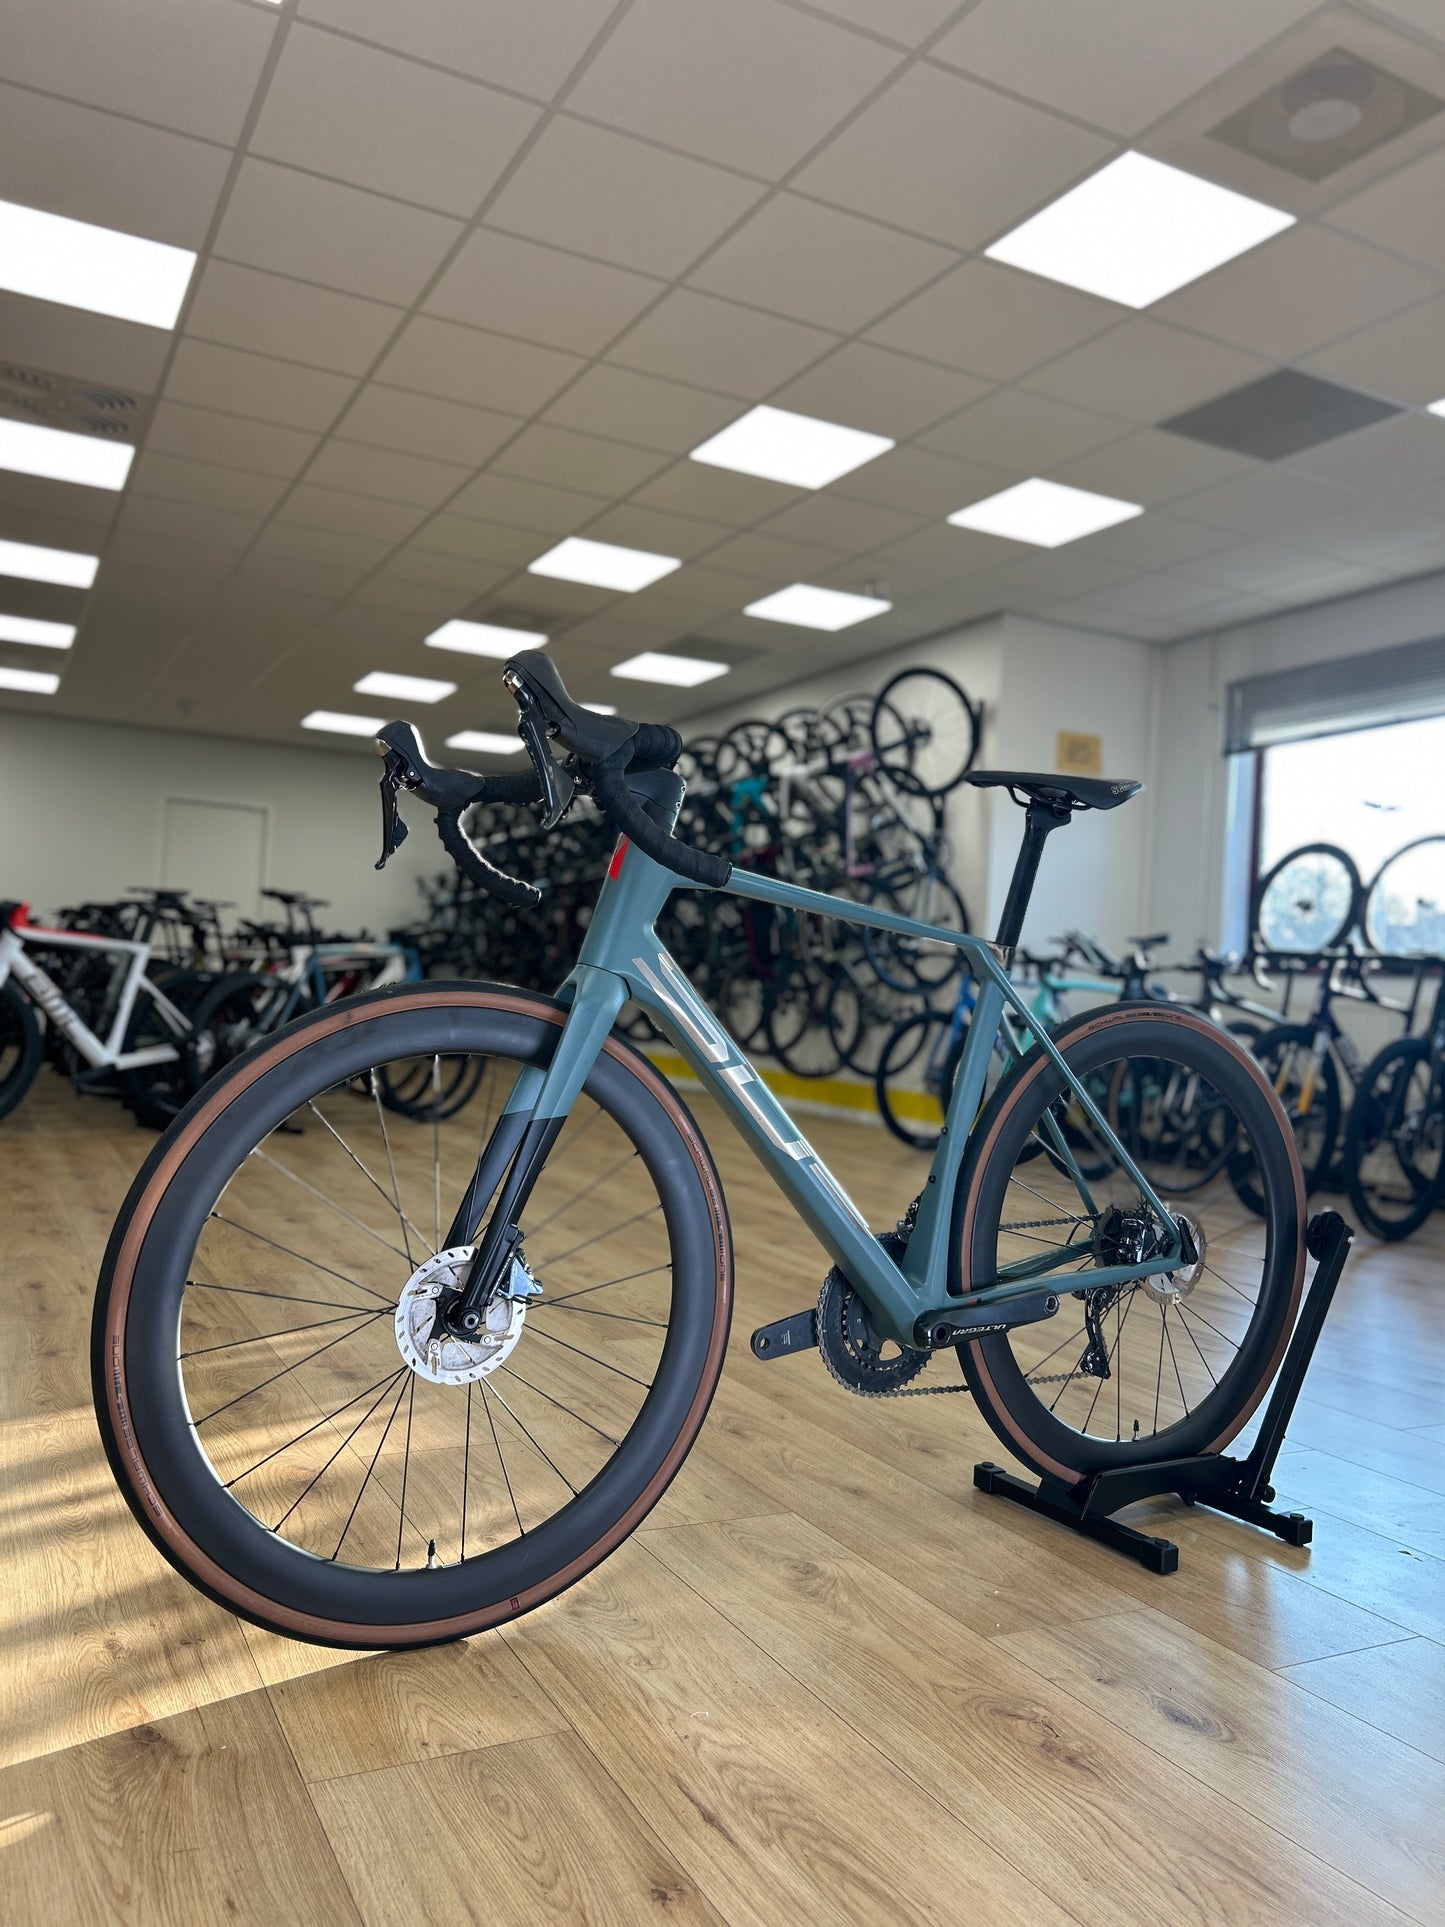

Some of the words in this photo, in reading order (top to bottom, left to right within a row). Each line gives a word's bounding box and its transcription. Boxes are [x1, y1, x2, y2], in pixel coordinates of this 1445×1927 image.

[952, 1324, 1007, 1336] ULTEGRA
[112, 1335, 120, 1367] ONE
[121, 1426, 162, 1517] SCHWALBE
